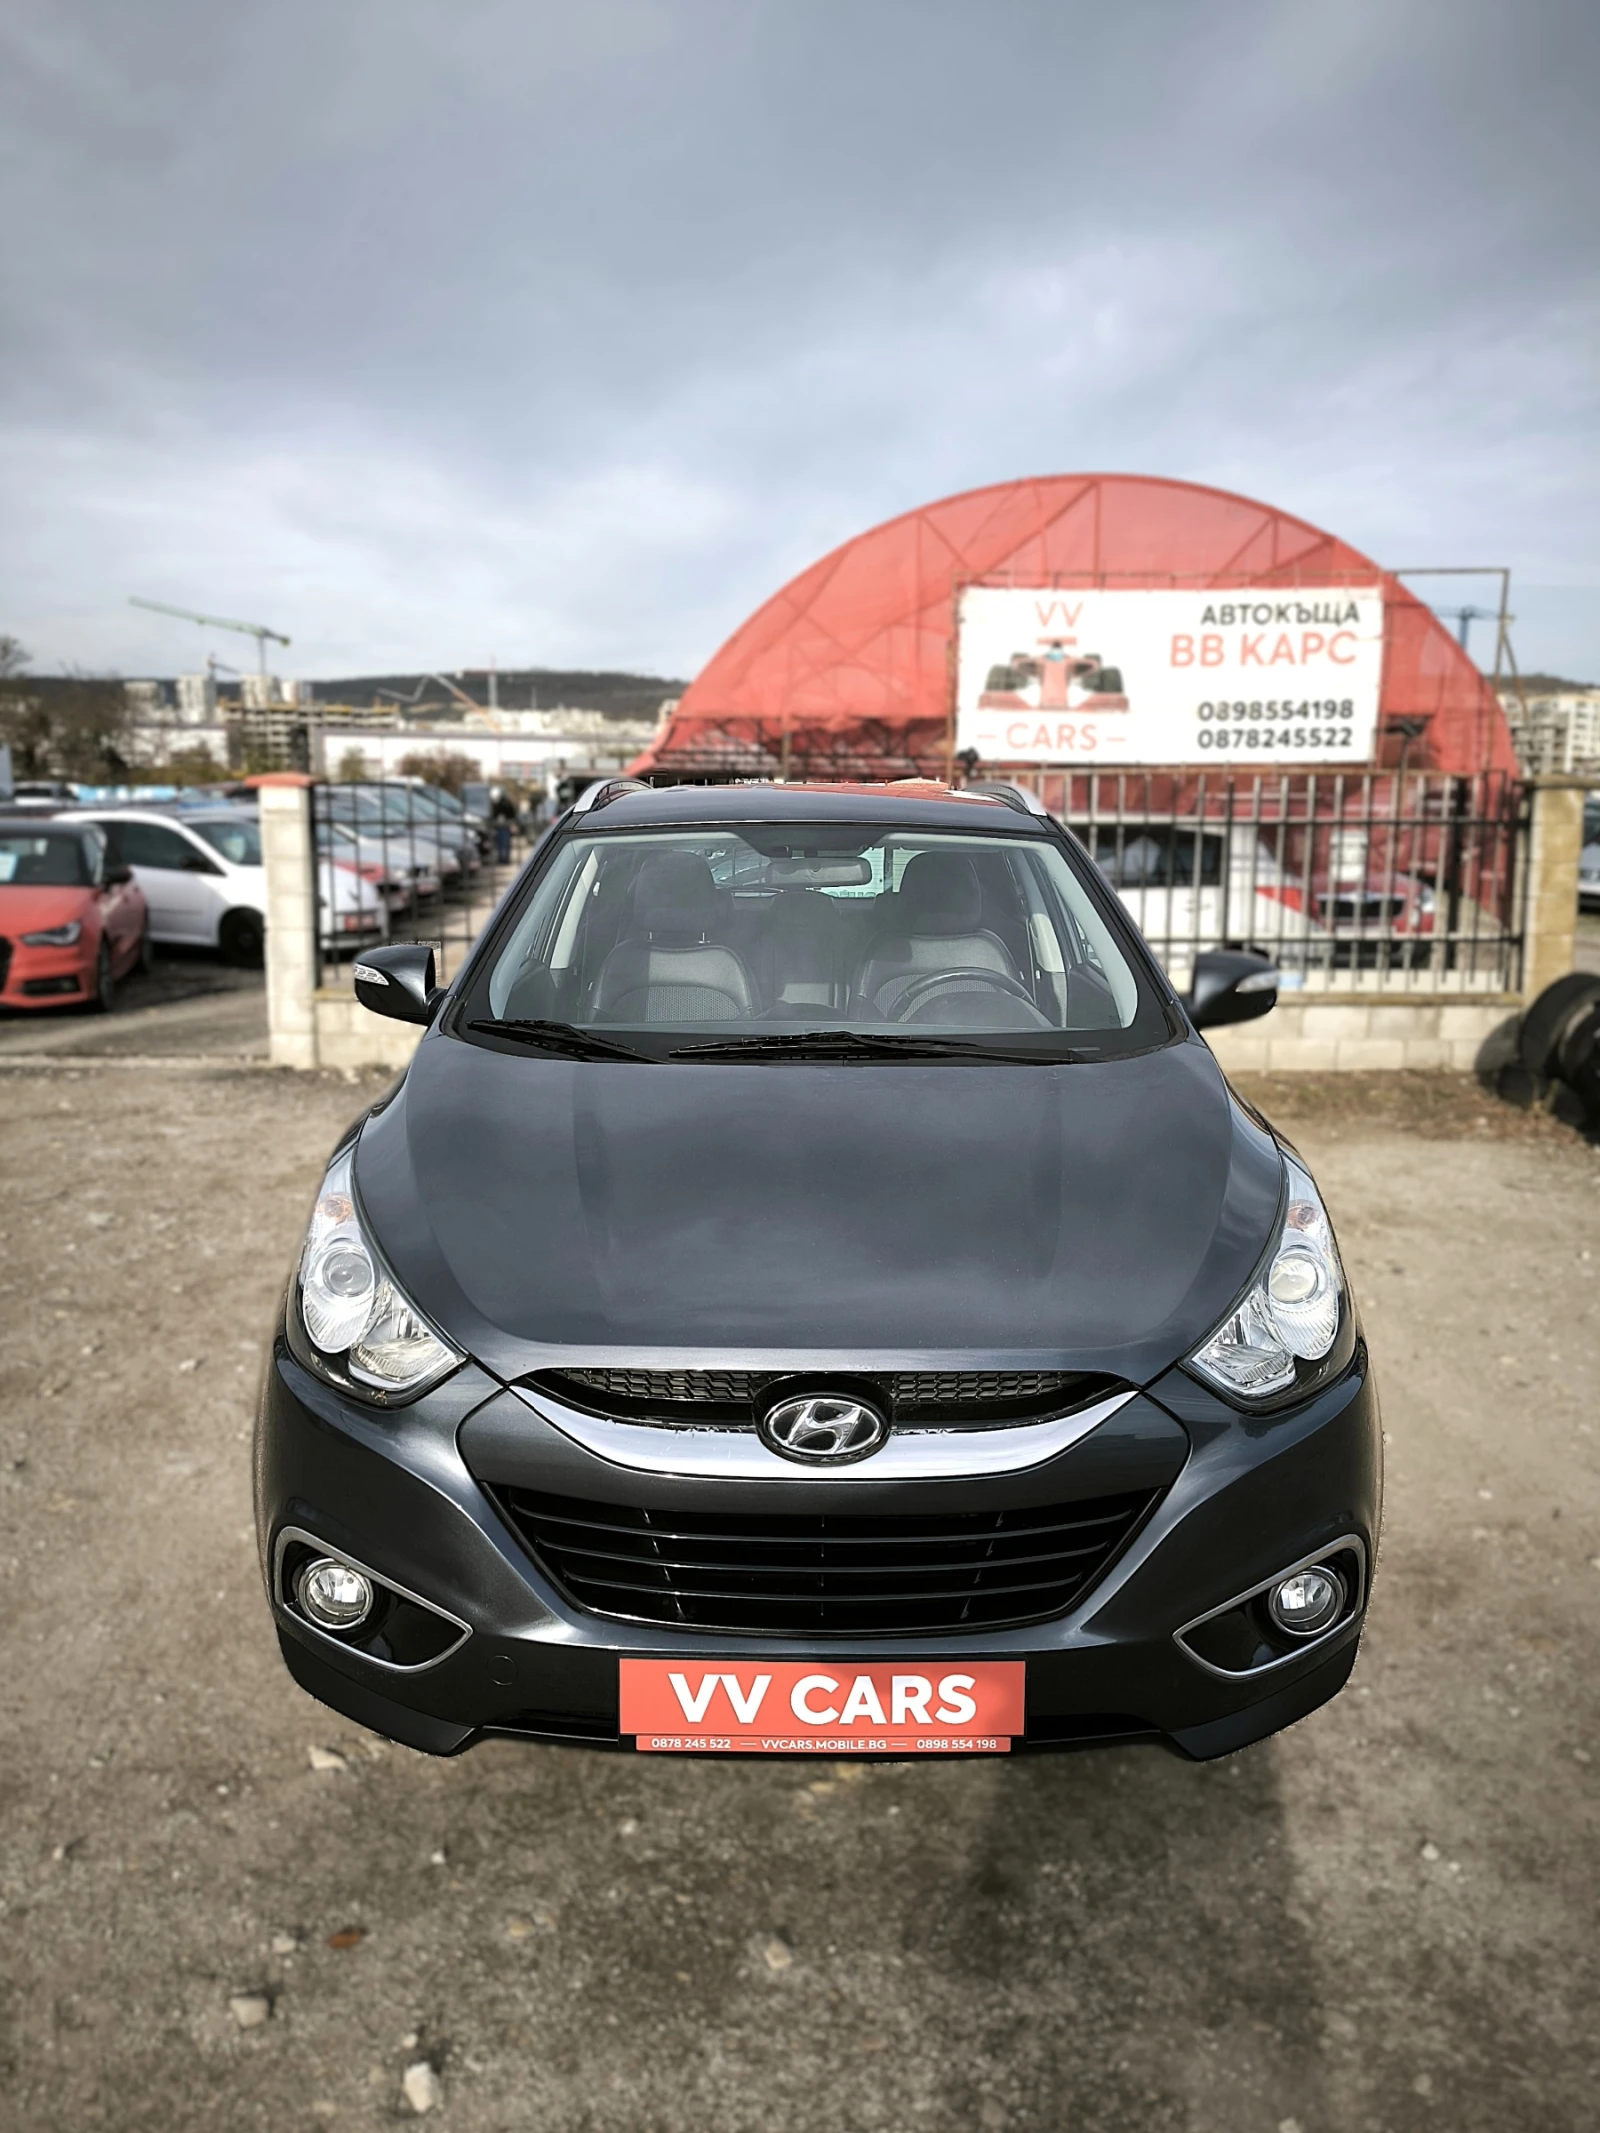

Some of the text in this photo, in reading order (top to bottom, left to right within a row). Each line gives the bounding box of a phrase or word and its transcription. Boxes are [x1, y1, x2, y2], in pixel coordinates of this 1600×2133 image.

[1034, 601, 1084, 628] VV
[1200, 602, 1361, 626] АВТОКЪЩА
[1169, 630, 1358, 668] ВВ КАРС
[1198, 698, 1354, 722] 0898554198
[1006, 722, 1098, 751] CARS
[1197, 726, 1353, 749] 0878245522
[668, 1673, 977, 1725] VV CARS
[651, 1737, 997, 1751] 0878 245 522 VVCARS.MOBILE.BG 0898 554 198
